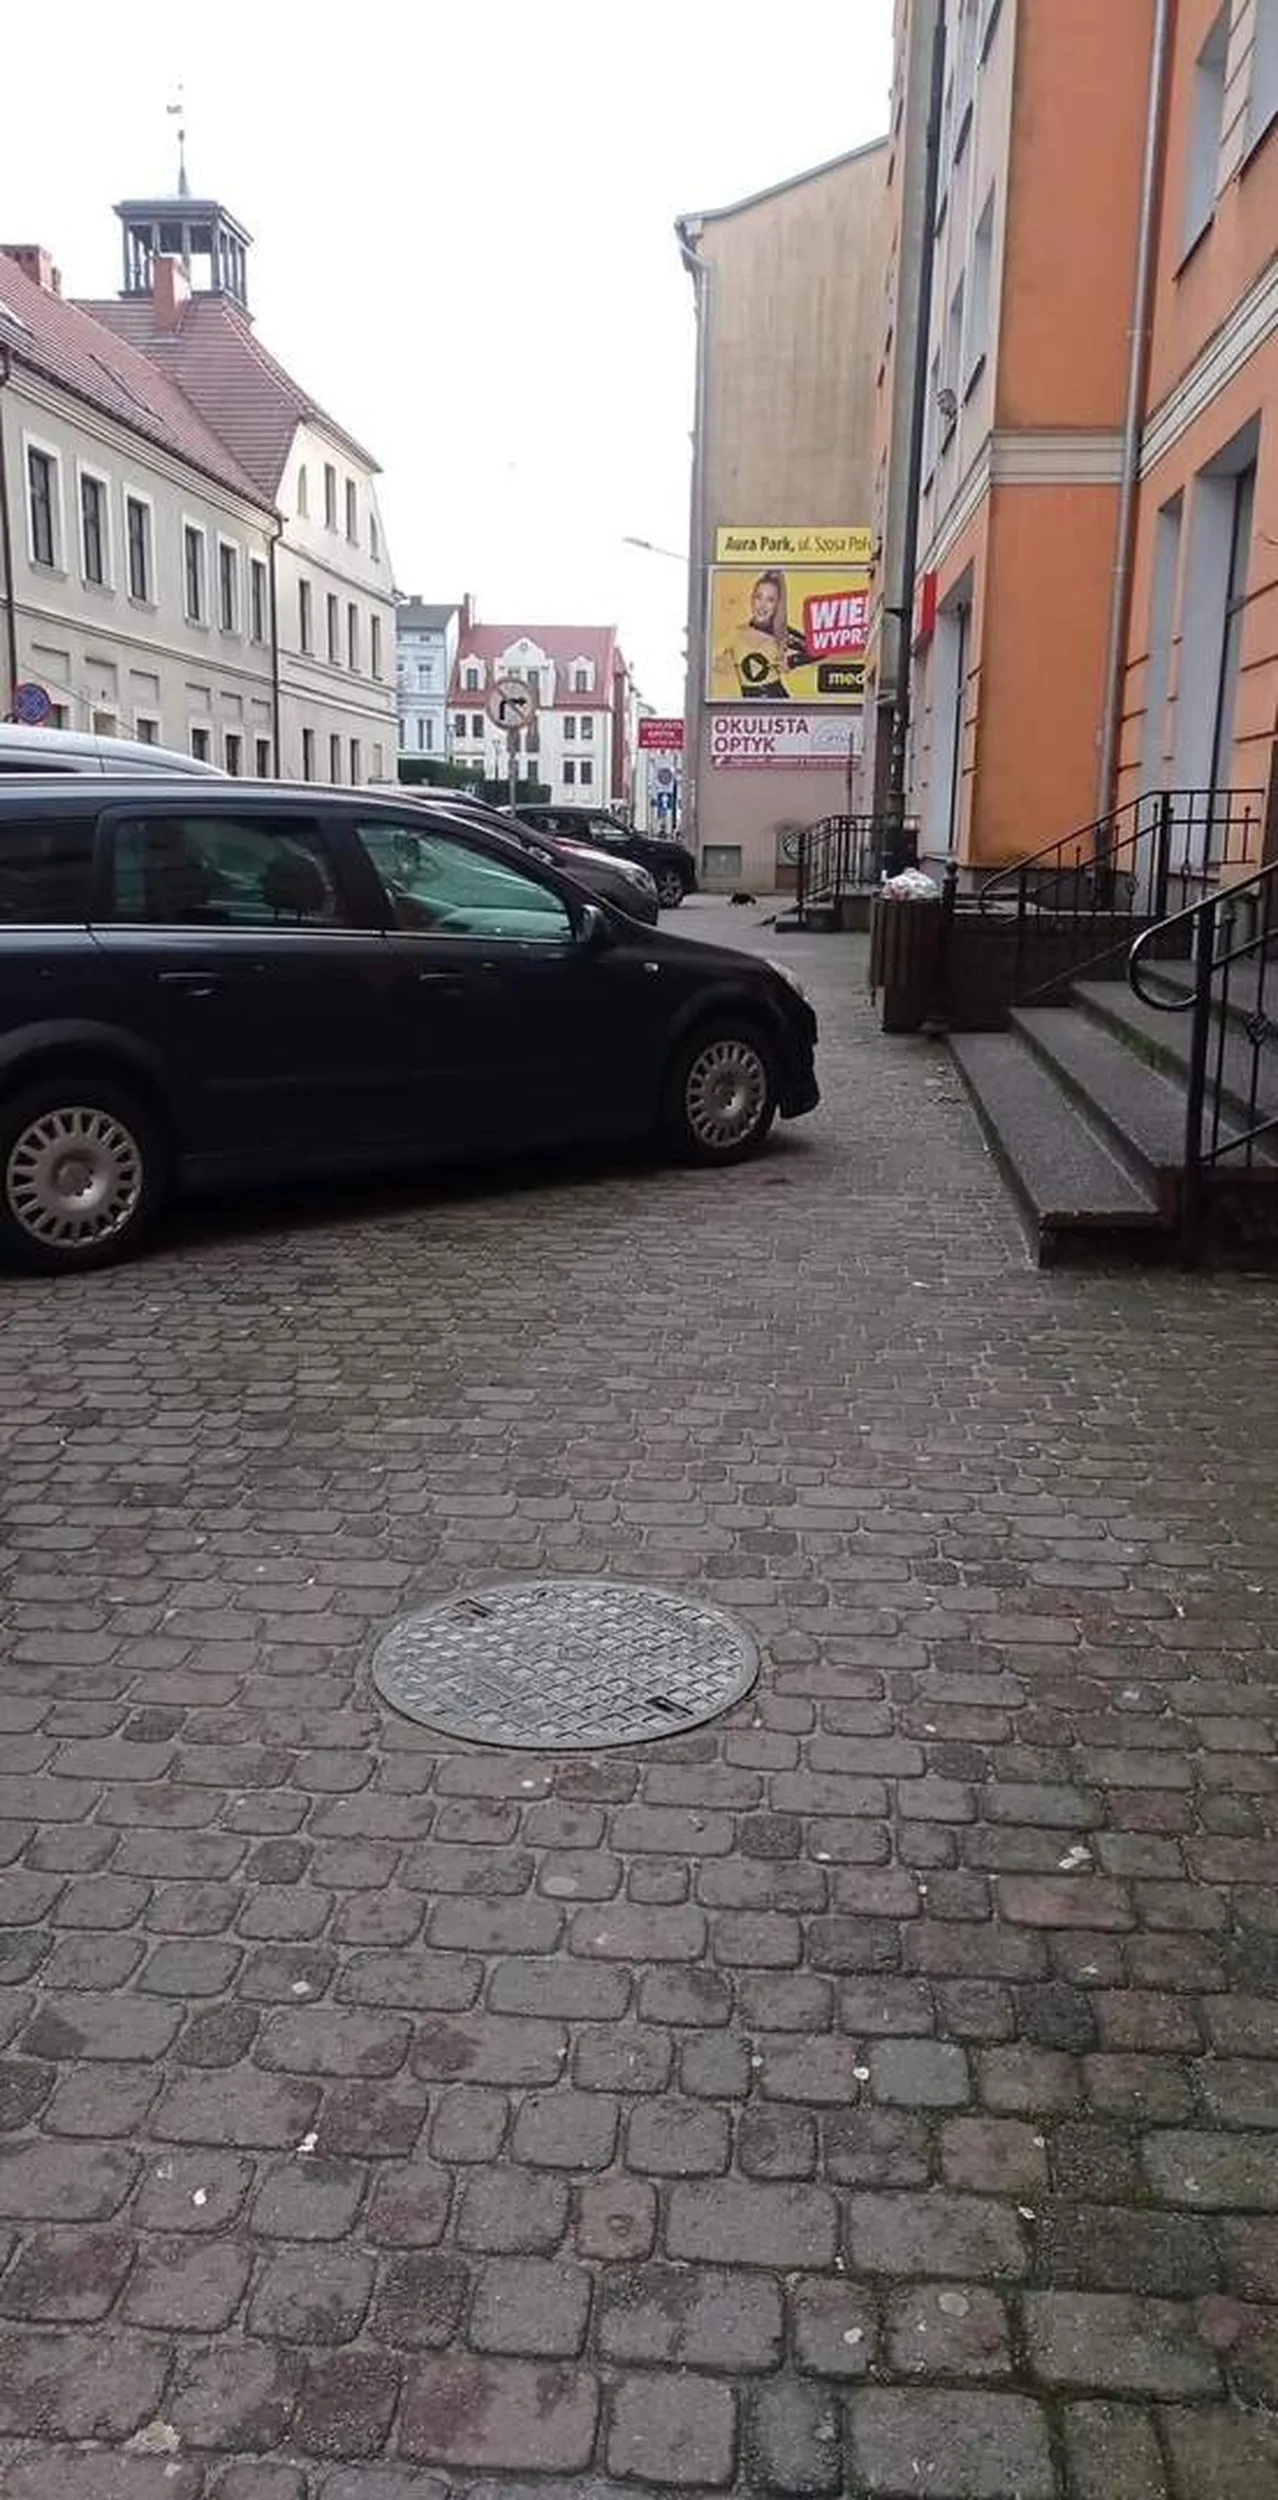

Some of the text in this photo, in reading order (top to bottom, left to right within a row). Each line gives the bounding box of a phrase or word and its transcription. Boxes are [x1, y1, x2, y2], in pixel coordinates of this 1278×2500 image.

[725, 536, 757, 551] Aura
[760, 536, 795, 553] Park,
[715, 719, 808, 734] OKULISTA
[714, 736, 775, 752] OPTYK
